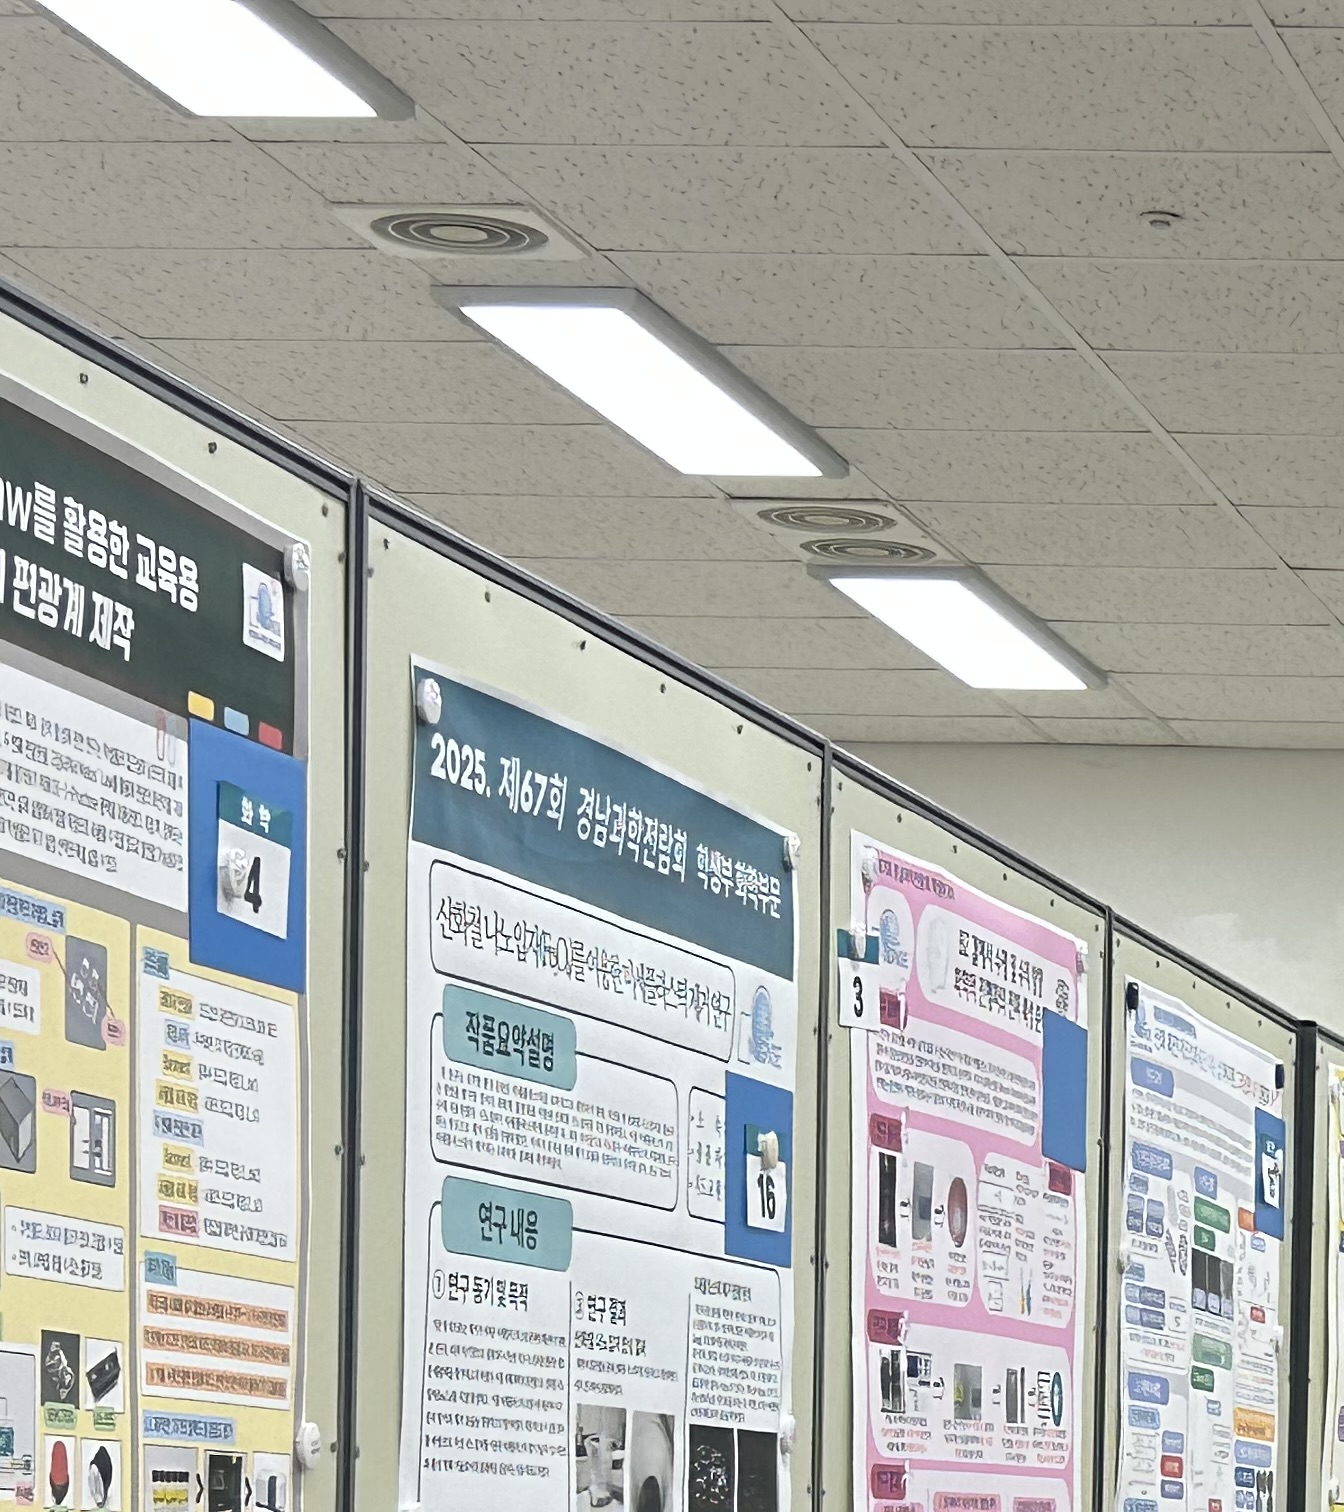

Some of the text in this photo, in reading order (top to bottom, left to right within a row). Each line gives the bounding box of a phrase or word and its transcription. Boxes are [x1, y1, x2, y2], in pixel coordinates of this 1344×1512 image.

[63, 496, 130, 579] 활용한
[136, 532, 199, 613] 교육용
[13, 555, 135, 662] 편광계 제작
[430, 732, 490, 797] 2025.
[498, 757, 568, 830] 제67회
[577, 786, 687, 882] 경남과학전람회
[244, 856, 262, 913] 4
[852, 976, 864, 1018] 3
[756, 1171, 777, 1221] 16
[478, 1200, 540, 1252] 연구 내용
